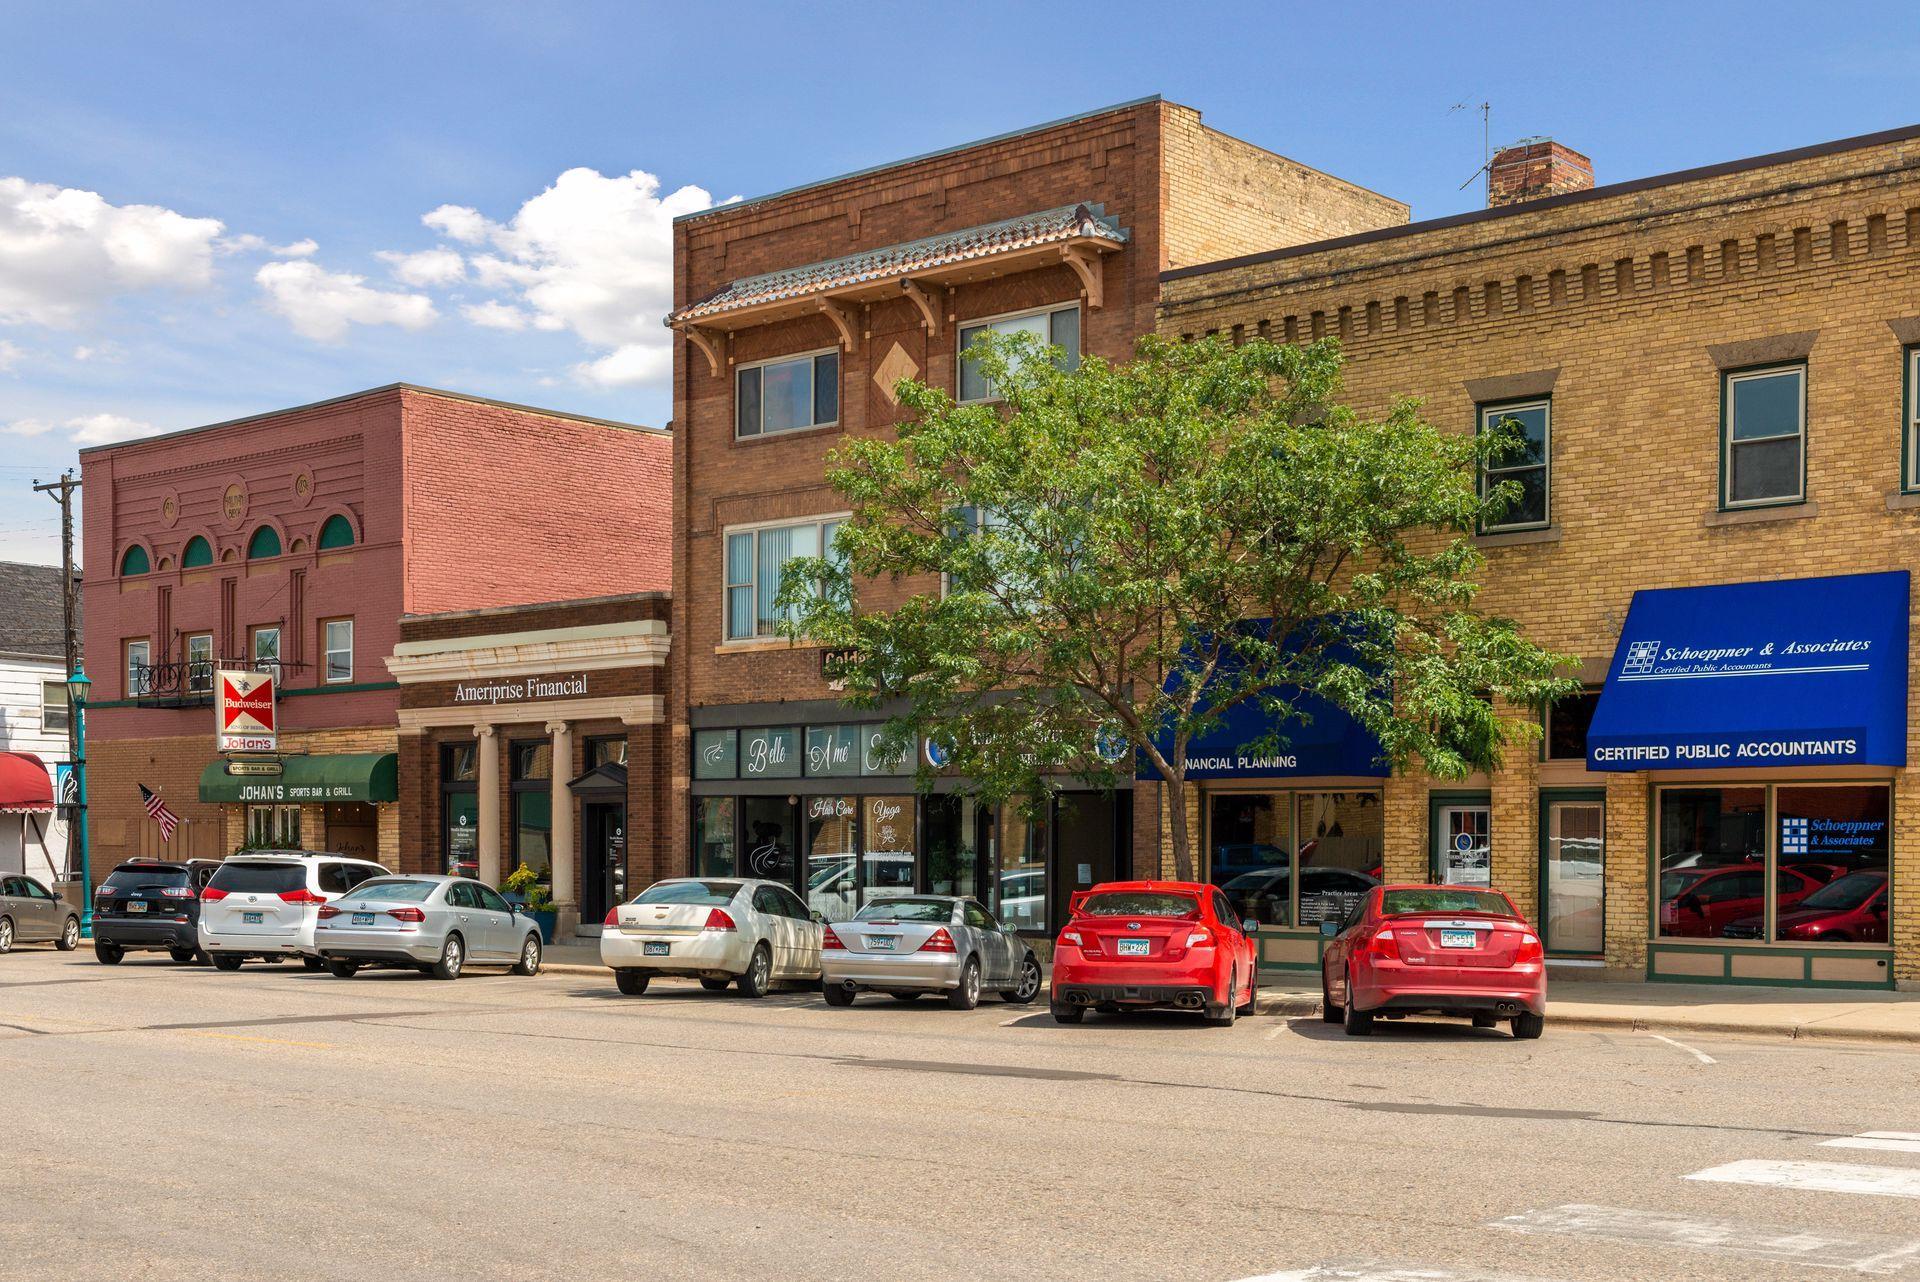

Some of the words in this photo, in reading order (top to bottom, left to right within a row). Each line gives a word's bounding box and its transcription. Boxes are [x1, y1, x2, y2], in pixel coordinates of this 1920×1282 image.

[1661, 646, 1754, 661] Schoeppner
[1760, 642, 1775, 656] &
[1780, 638, 1872, 655] Associates
[1654, 665, 1690, 674] Certified
[1692, 664, 1718, 673] Public
[1720, 662, 1772, 671] Accountants
[454, 680, 523, 704] Ameriprise
[526, 674, 587, 698] Financial
[225, 697, 272, 709] Budweiser
[748, 736, 785, 773] Belle
[1594, 746, 1670, 761] CERTIFIED
[1676, 743, 1731, 759] PUBLIC
[1736, 739, 1857, 758] ACCOUNTANTS
[1237, 755, 1297, 769] PLANNING
[239, 785, 284, 800] JOHAN'S
[289, 787, 311, 797] SPORTS
[311, 787, 323, 797] BAR
[325, 787, 331, 797] &
[333, 787, 353, 796] GRILL
[809, 800, 834, 818] Hair
[835, 800, 854, 817] Care
[873, 799, 901, 823] Yoga
[1810, 818, 1884, 834] Schoeppner
[1810, 835, 1819, 845] &
[1820, 835, 1875, 845] Associates
[1443, 935, 1456, 943] CHC
